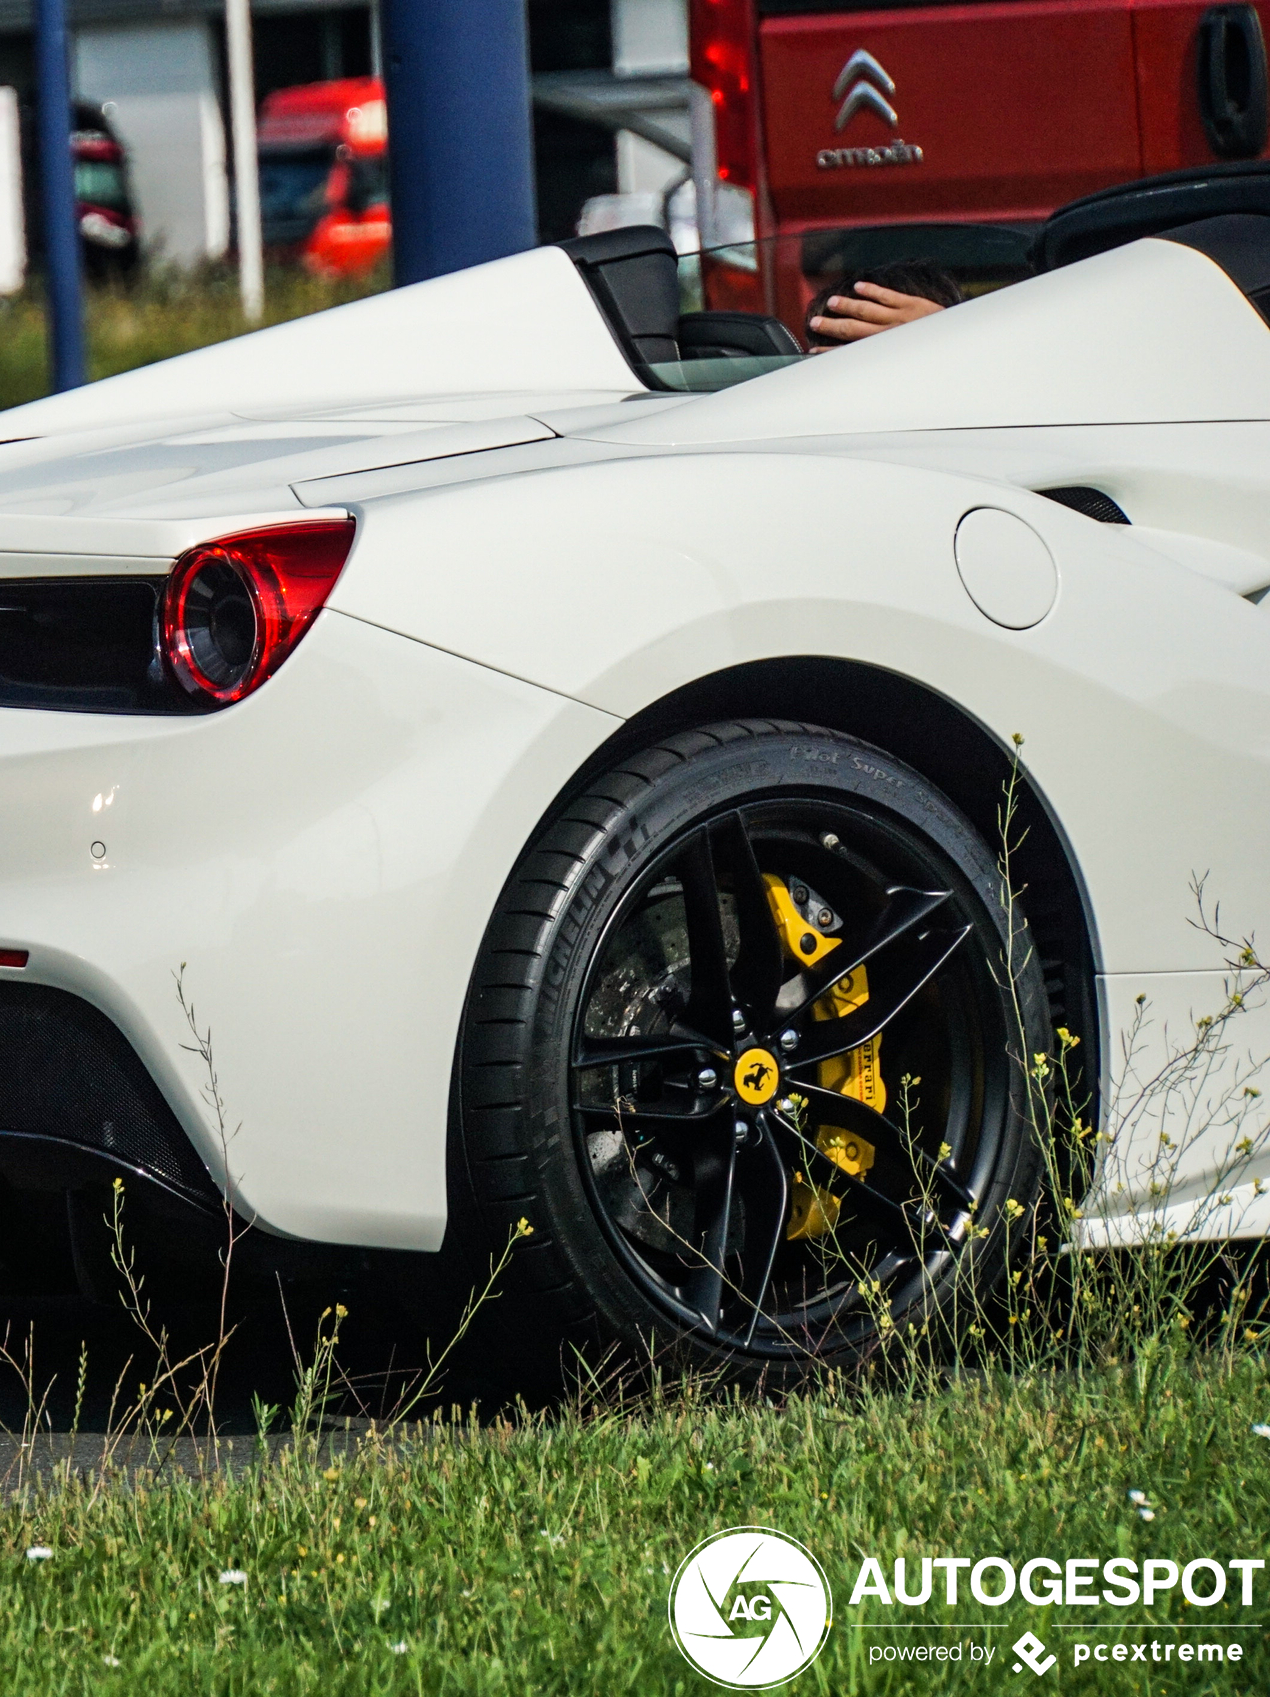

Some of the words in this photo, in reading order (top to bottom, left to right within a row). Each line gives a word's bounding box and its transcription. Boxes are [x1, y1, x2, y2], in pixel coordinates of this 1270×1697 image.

[789, 745, 841, 765] Pilot
[850, 756, 905, 788] Super
[535, 863, 607, 1037] MICHELIN
[863, 1043, 875, 1101] errari
